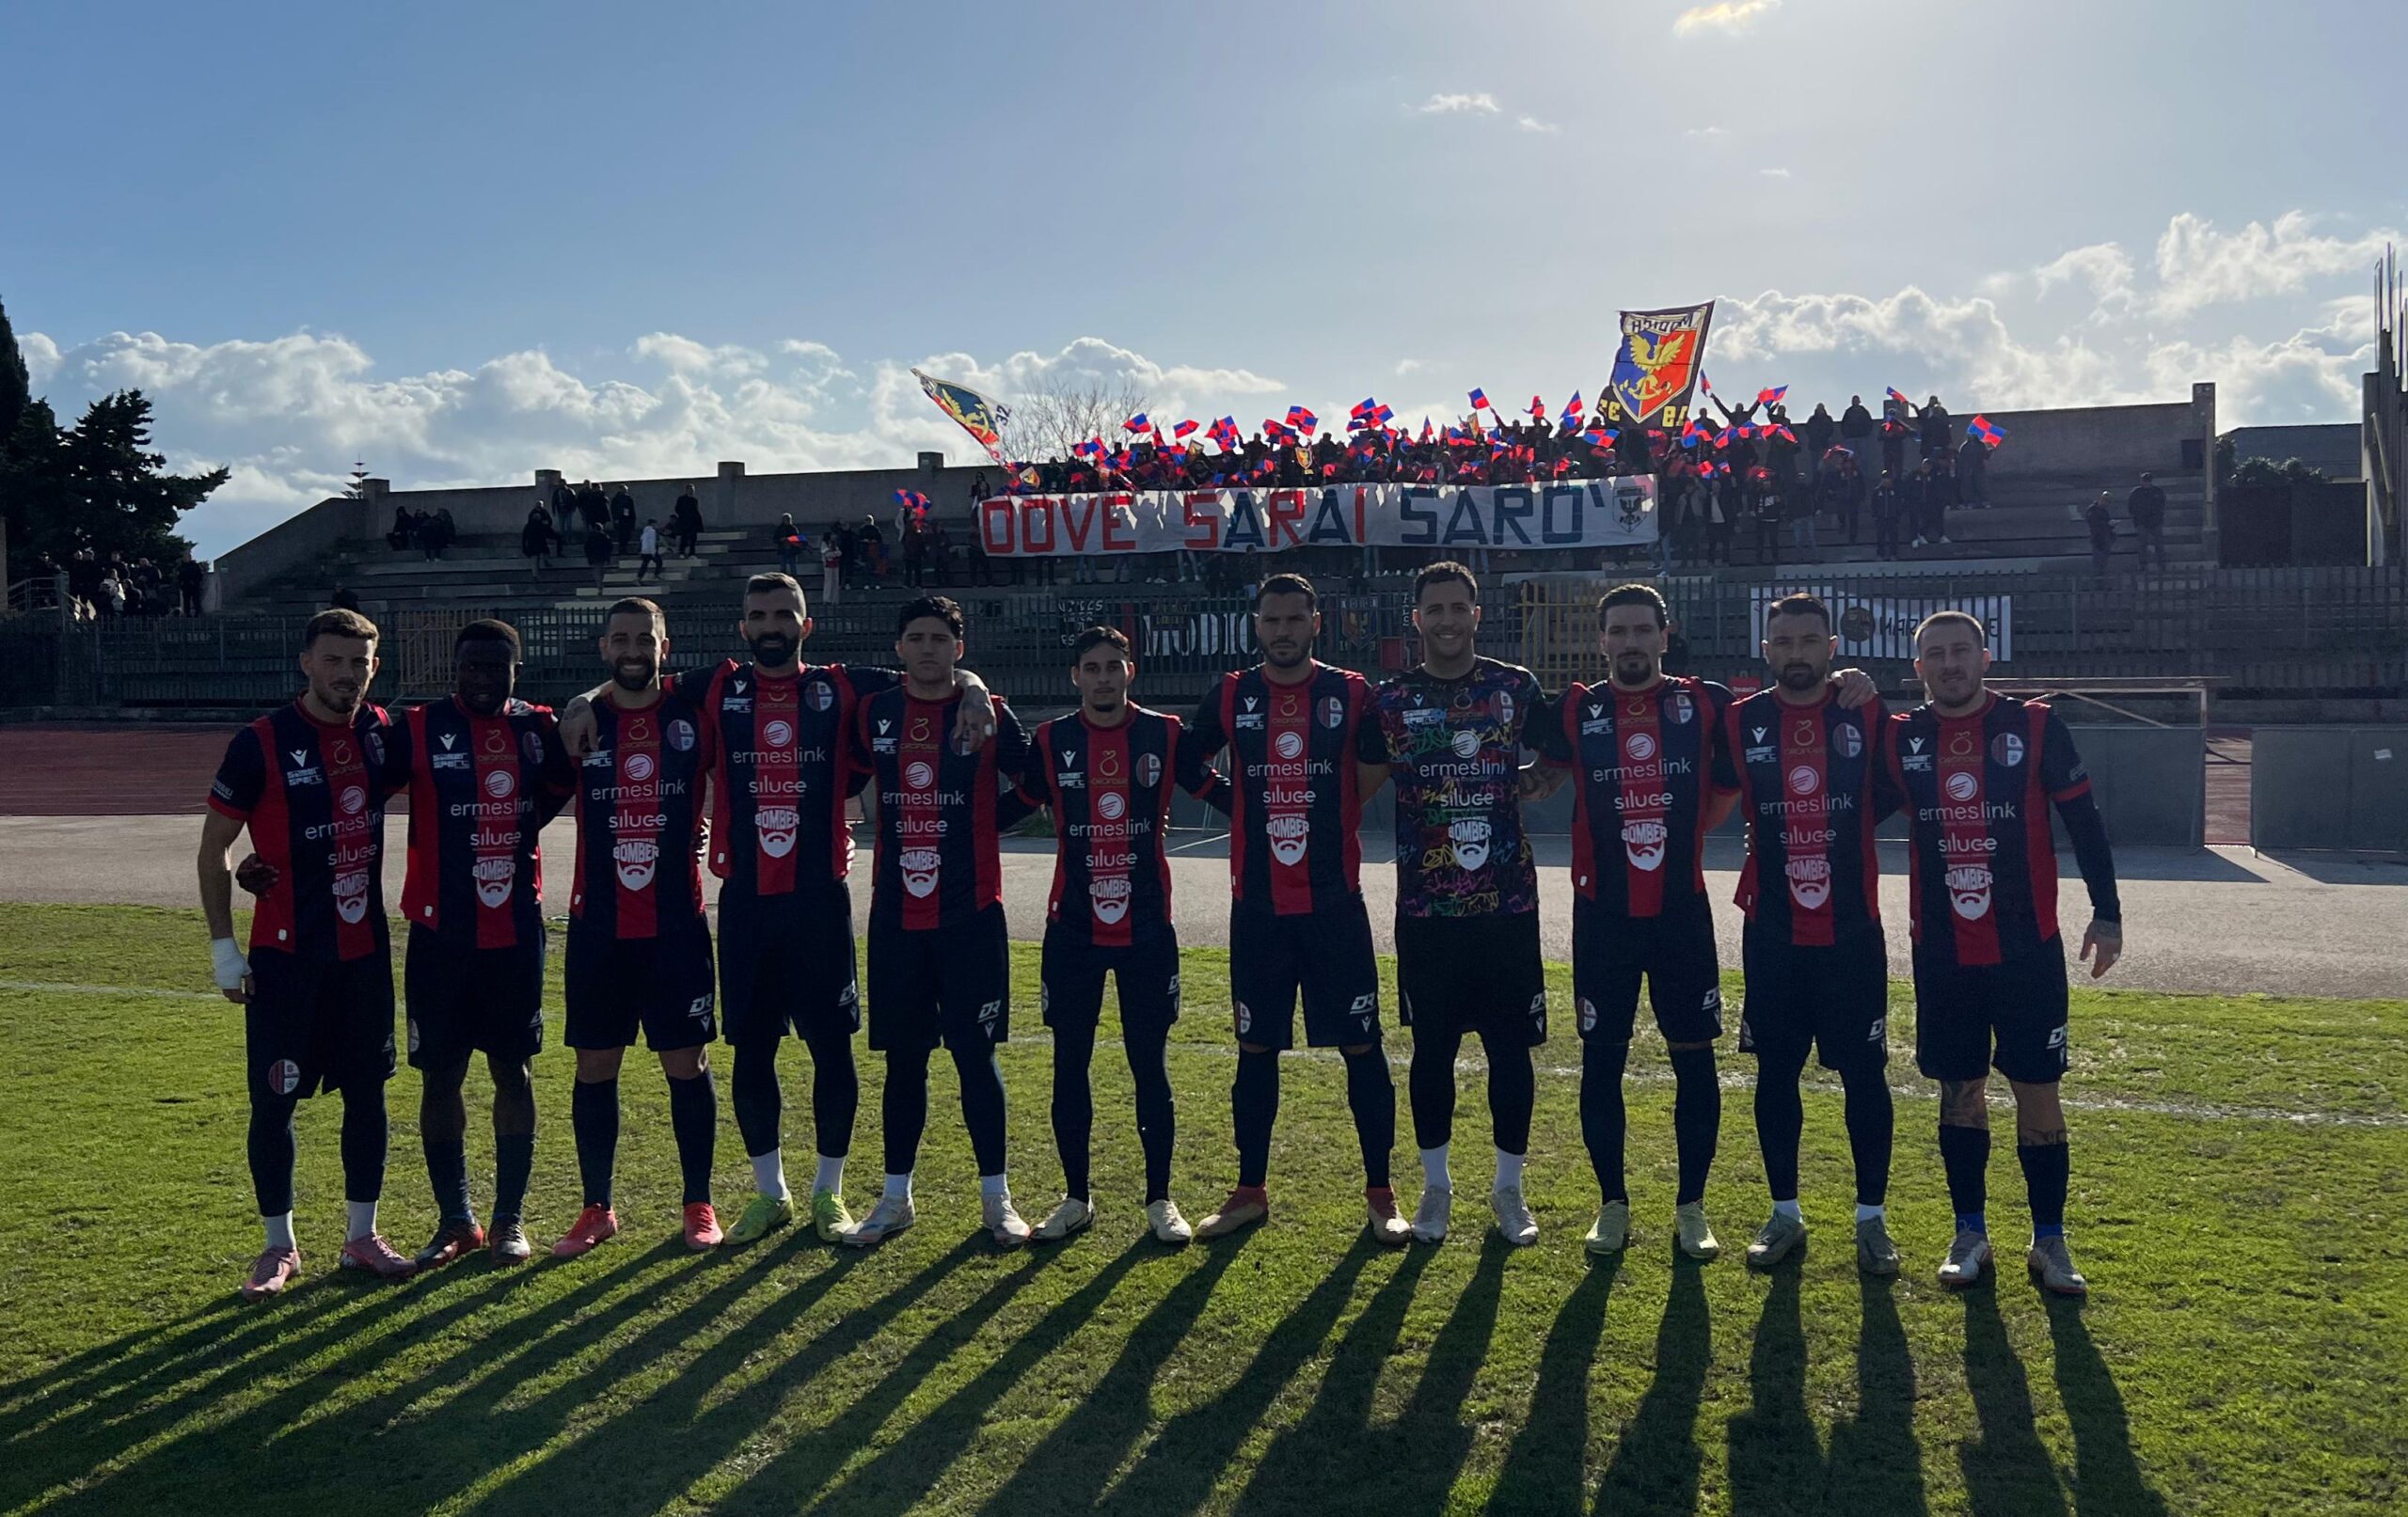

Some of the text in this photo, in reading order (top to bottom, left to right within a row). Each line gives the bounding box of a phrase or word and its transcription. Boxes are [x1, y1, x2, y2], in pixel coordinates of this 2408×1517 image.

[1184, 486, 1365, 548] SARAI
[732, 746, 826, 764] ermeslink
[1247, 758, 1333, 777] ermeslink
[1593, 757, 1691, 782] ermeslink
[592, 778, 687, 800] ermeslink
[1760, 793, 1853, 815] ermeslink
[1919, 801, 2017, 821] ermeslink
[754, 808, 800, 831] BOMBER
[1069, 817, 1151, 837] ermeslink
[1266, 816, 1310, 839] BOMBER
[1448, 820, 1492, 843] BOMBER
[1621, 822, 1668, 845] BOMBER
[613, 842, 659, 864] BOMBER
[899, 849, 942, 872] BOMBER
[472, 859, 516, 881] BOMBER
[1784, 860, 1831, 881] BOMBER
[1944, 867, 1994, 892] BOMBER
[1088, 877, 1133, 899] BOMBER
